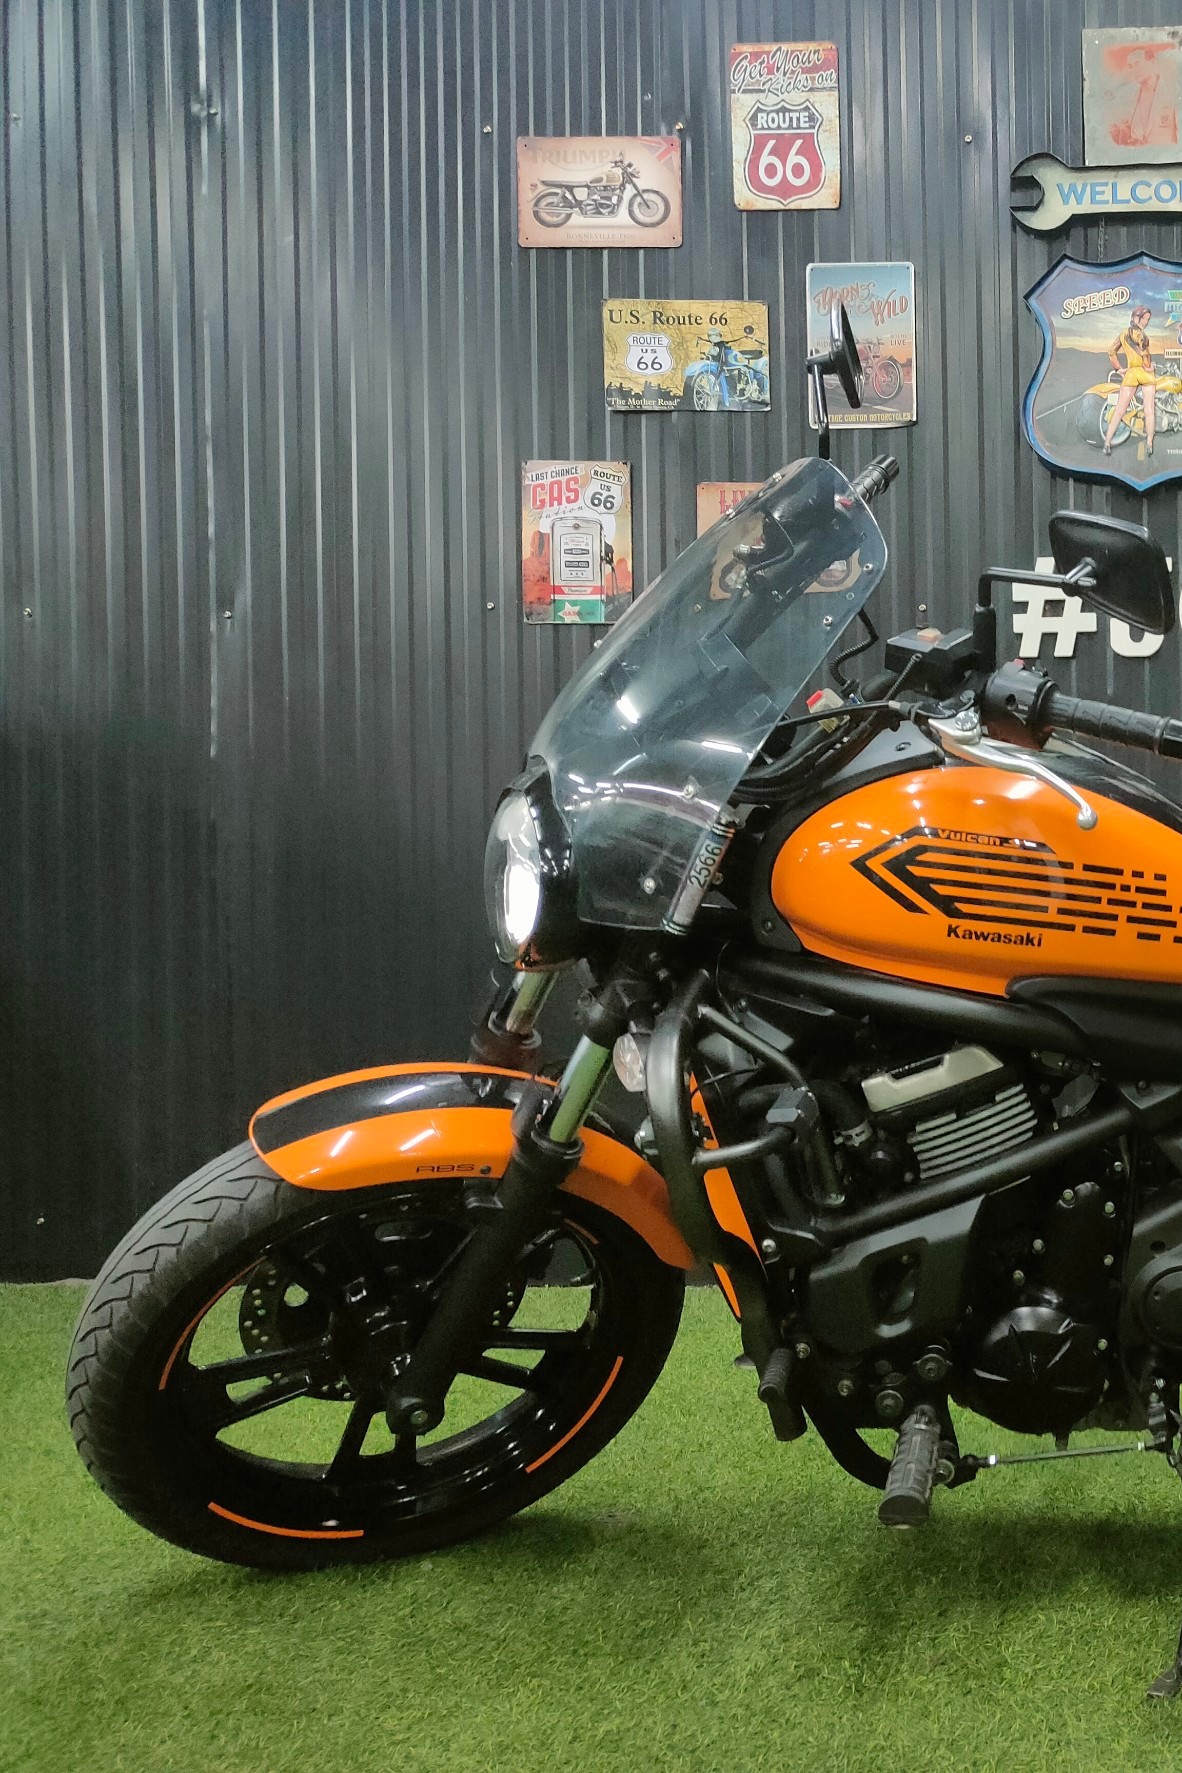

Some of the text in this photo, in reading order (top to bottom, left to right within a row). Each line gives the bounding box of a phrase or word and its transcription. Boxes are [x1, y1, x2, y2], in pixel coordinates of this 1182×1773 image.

[732, 45, 823, 94] Get Your
[762, 69, 836, 100] Kicks on
[757, 112, 810, 129] ROUTE
[530, 148, 627, 164] TRIUMPH
[758, 139, 811, 187] 66
[1061, 286, 1131, 319] SPEED
[608, 309, 728, 326] U.S. Route 66
[632, 335, 664, 346] ROUTE
[636, 355, 663, 371] 66
[627, 397, 657, 406] Mother
[530, 466, 579, 483] LAST CHANCE
[592, 469, 623, 483] ROUTE
[531, 476, 581, 511] GAS
[600, 484, 612, 492] US
[590, 491, 616, 511] 66
[688, 844, 723, 889] 2566
[946, 923, 1043, 948] Kawasaki
[416, 1164, 475, 1173] ABS
